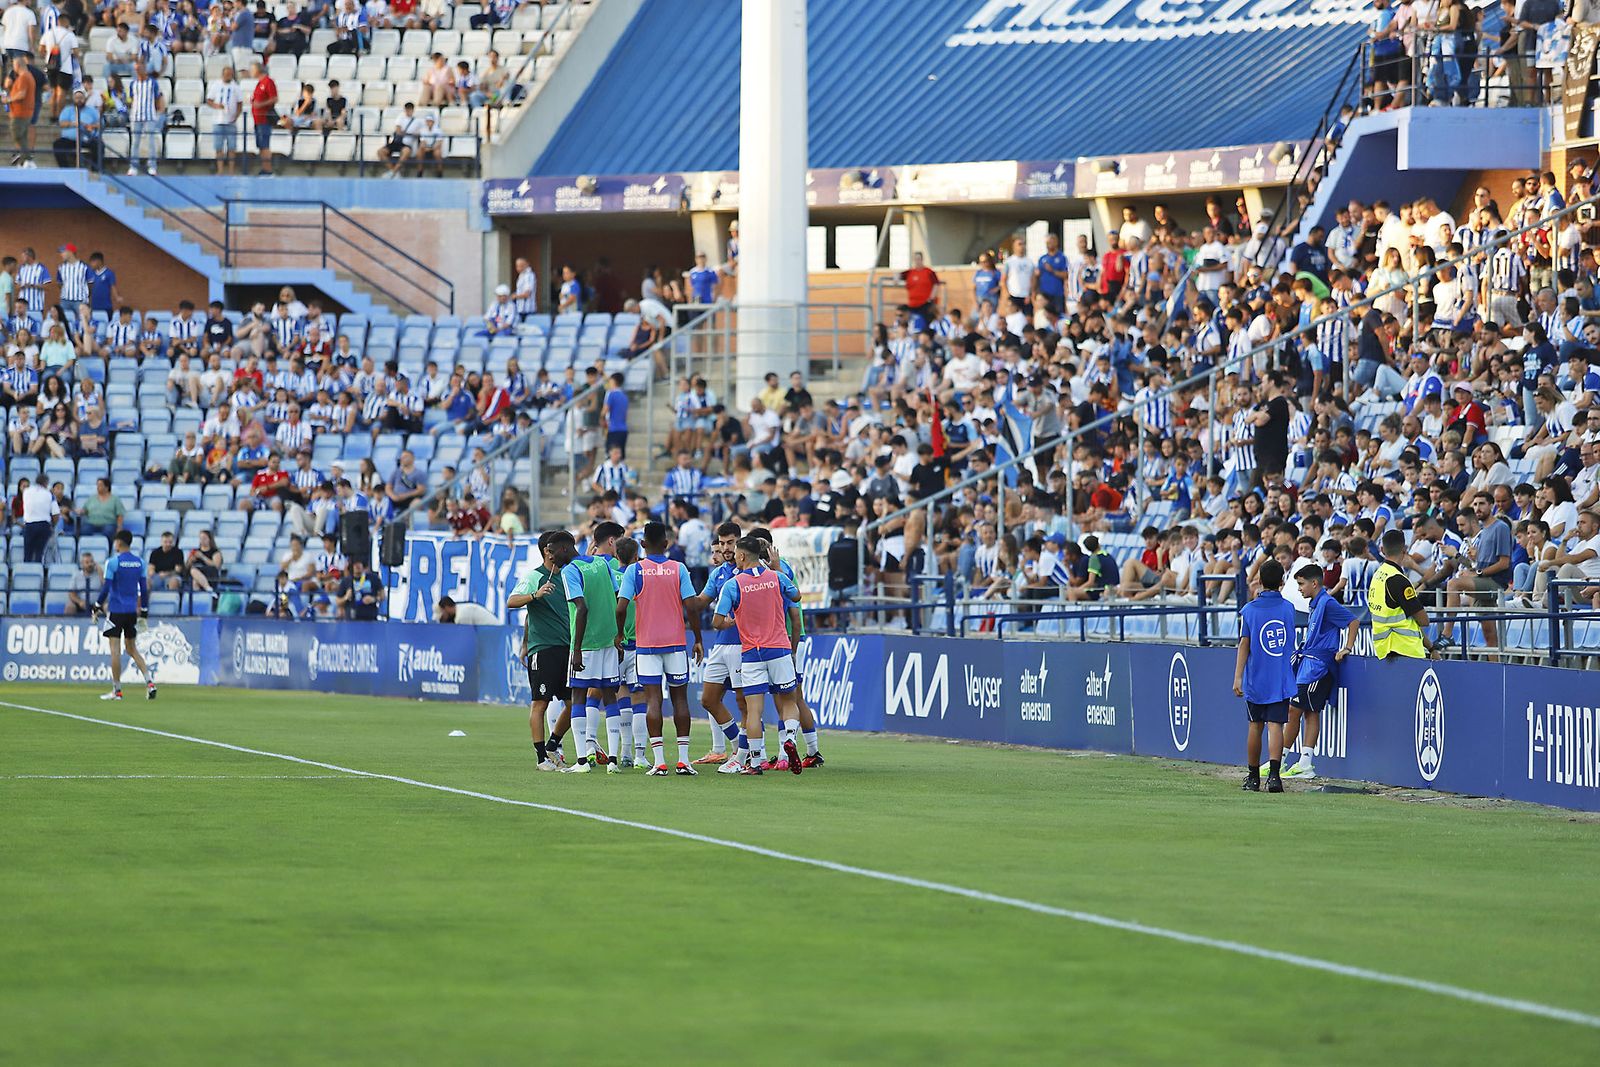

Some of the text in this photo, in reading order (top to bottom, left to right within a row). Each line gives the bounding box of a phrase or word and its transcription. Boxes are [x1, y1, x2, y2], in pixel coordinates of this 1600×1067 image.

[413, 645, 443, 672] auto
[20, 664, 67, 681] BOSCH
[437, 664, 466, 684] PARTS
[1020, 668, 1037, 694] alter
[1086, 670, 1103, 697] alter
[964, 664, 1002, 718] Veyser
[1021, 701, 1051, 722] enersun
[1086, 704, 1115, 726] enersun
